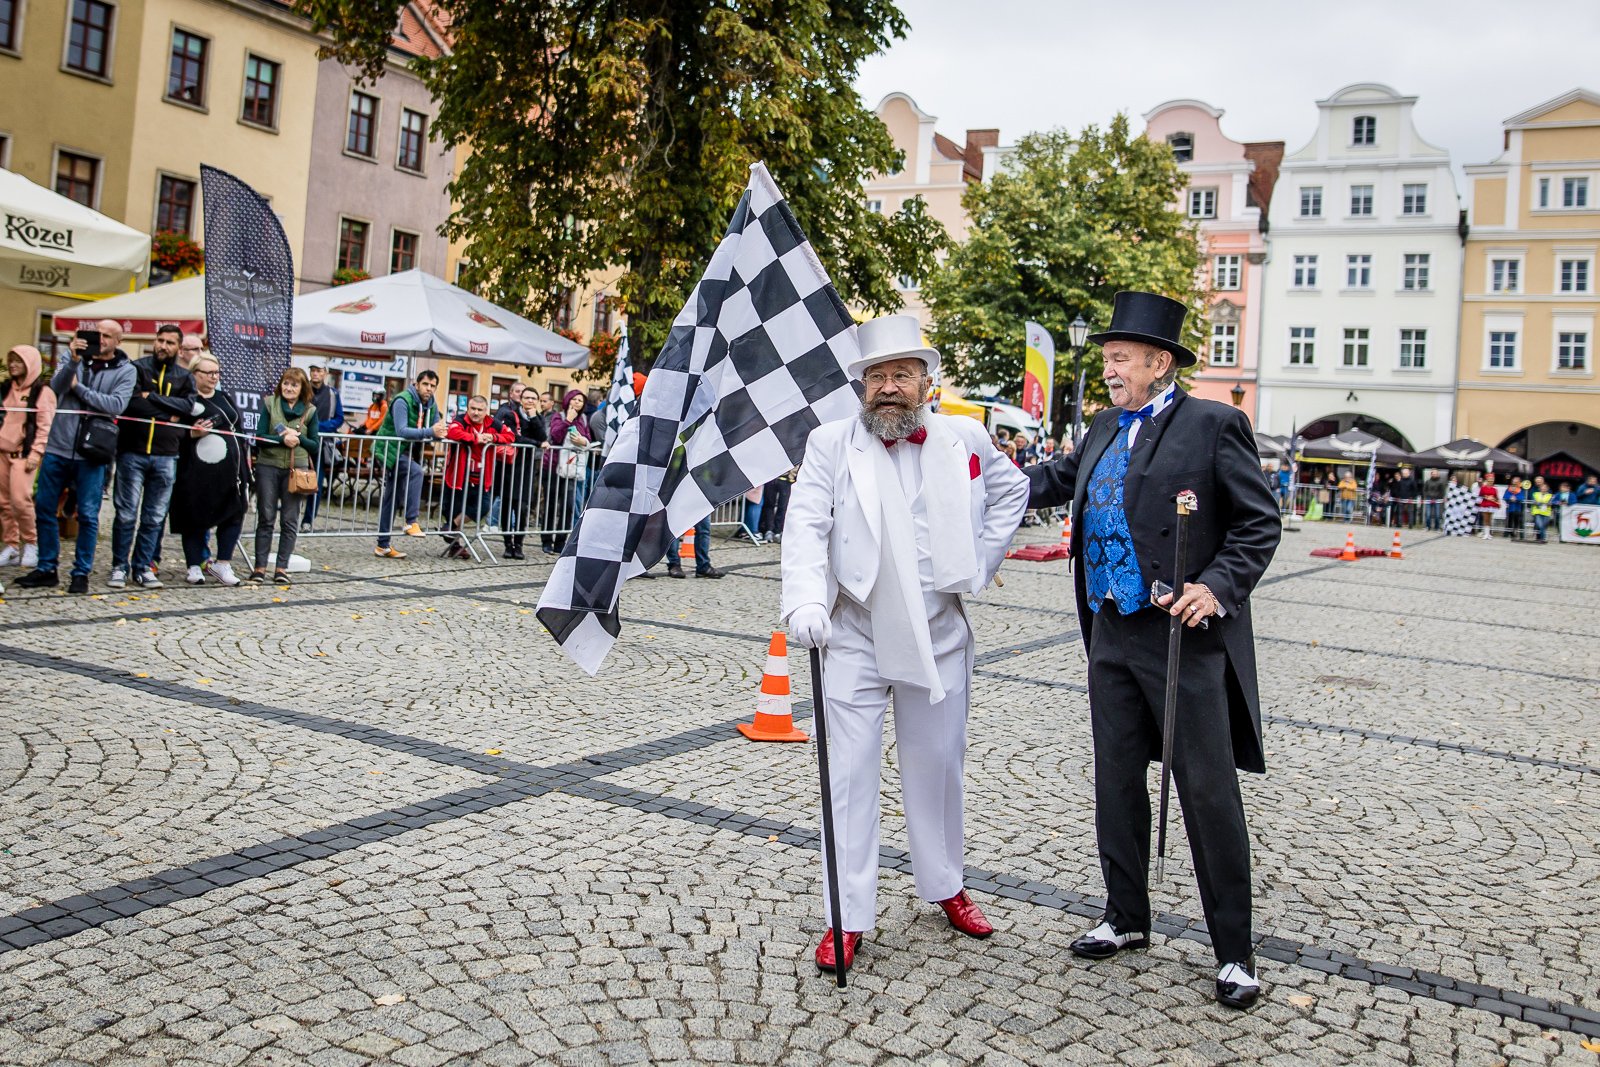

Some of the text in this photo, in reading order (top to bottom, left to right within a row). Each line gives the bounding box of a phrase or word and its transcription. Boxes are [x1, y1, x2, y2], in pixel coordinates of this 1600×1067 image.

[5, 213, 75, 250] Kozel
[362, 332, 384, 343] TYSKIE
[471, 342, 488, 353] TYSKIE
[1539, 462, 1584, 478] PIZZA
